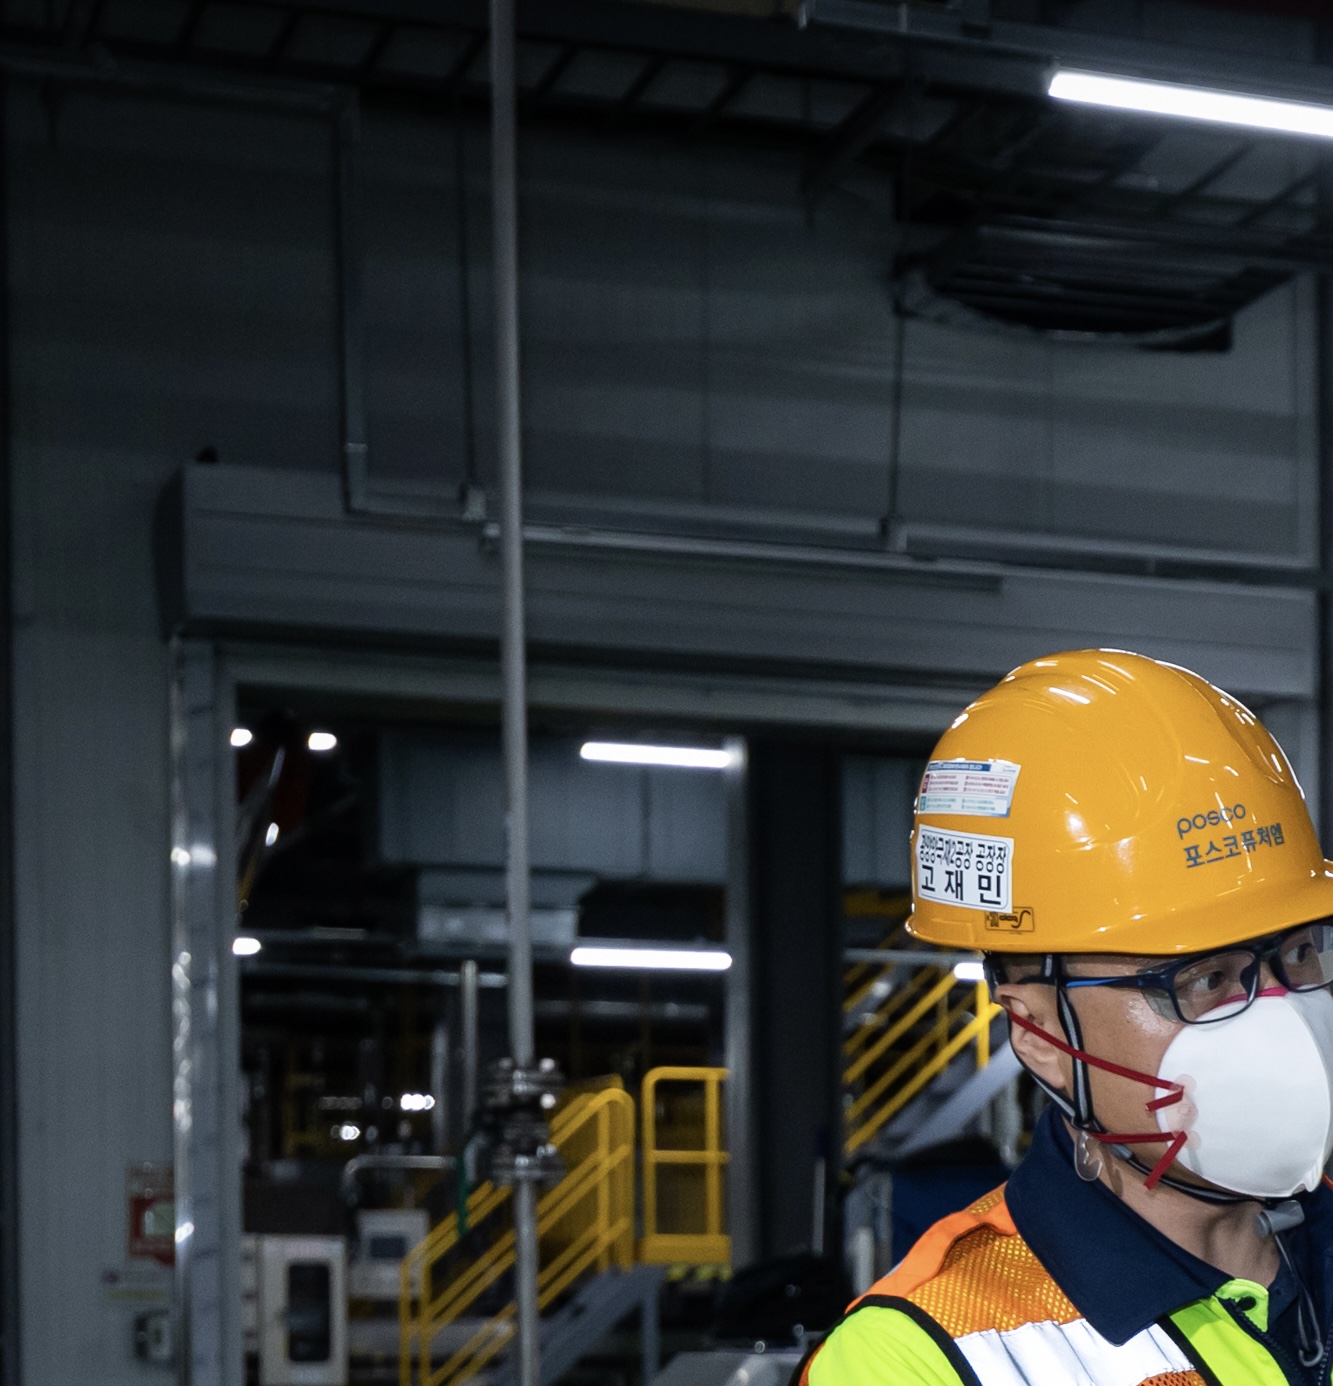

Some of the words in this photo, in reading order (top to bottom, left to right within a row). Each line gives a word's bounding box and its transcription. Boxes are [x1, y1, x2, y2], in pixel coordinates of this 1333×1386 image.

[1177, 804, 1246, 840] posco
[976, 843, 1006, 875] 공장장
[1184, 822, 1285, 868] 포스코퓨처엠
